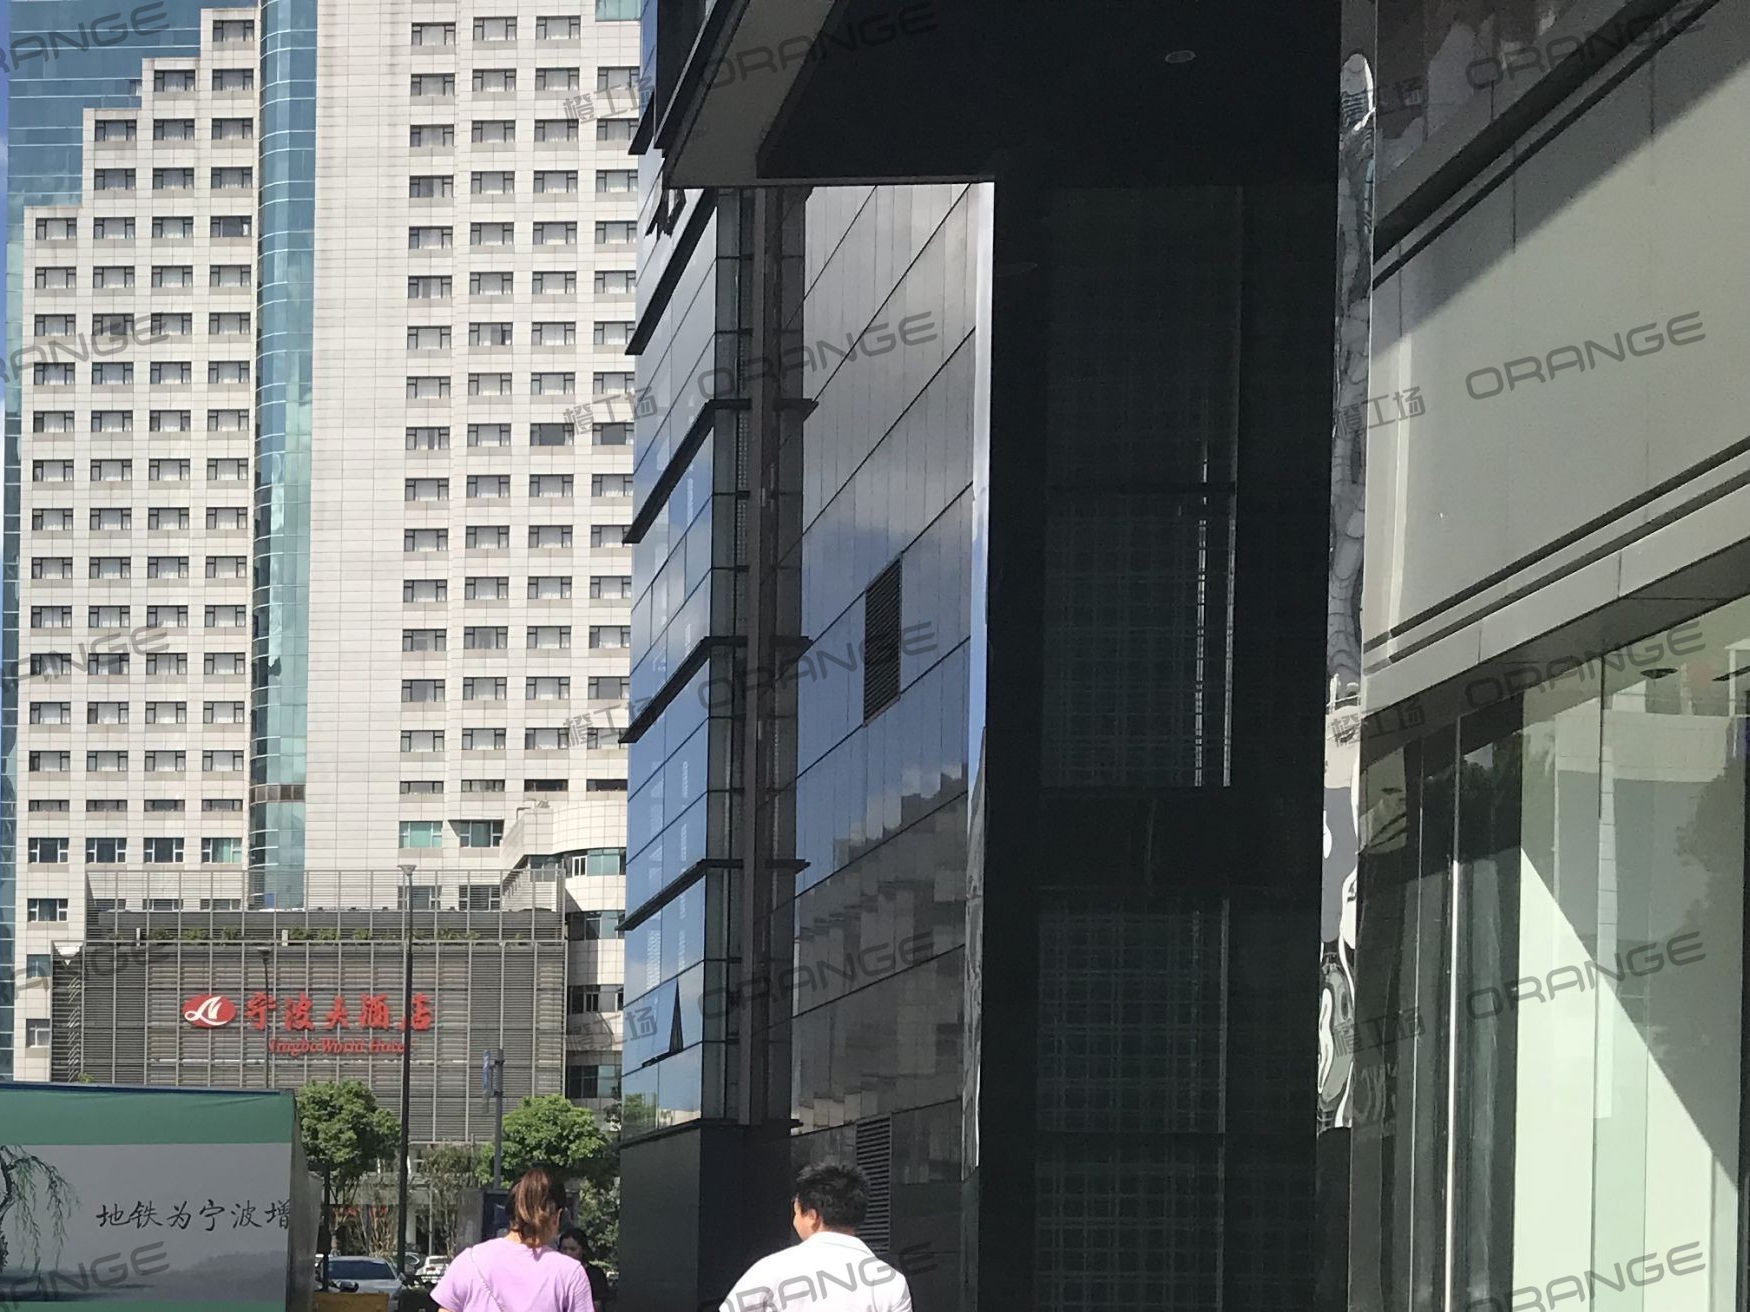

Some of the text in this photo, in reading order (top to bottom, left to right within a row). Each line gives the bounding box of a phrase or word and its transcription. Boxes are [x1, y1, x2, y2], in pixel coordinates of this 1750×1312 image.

[244, 991, 433, 1031] 宁波大酒店
[95, 1199, 291, 1232] 地铁为宁波增
